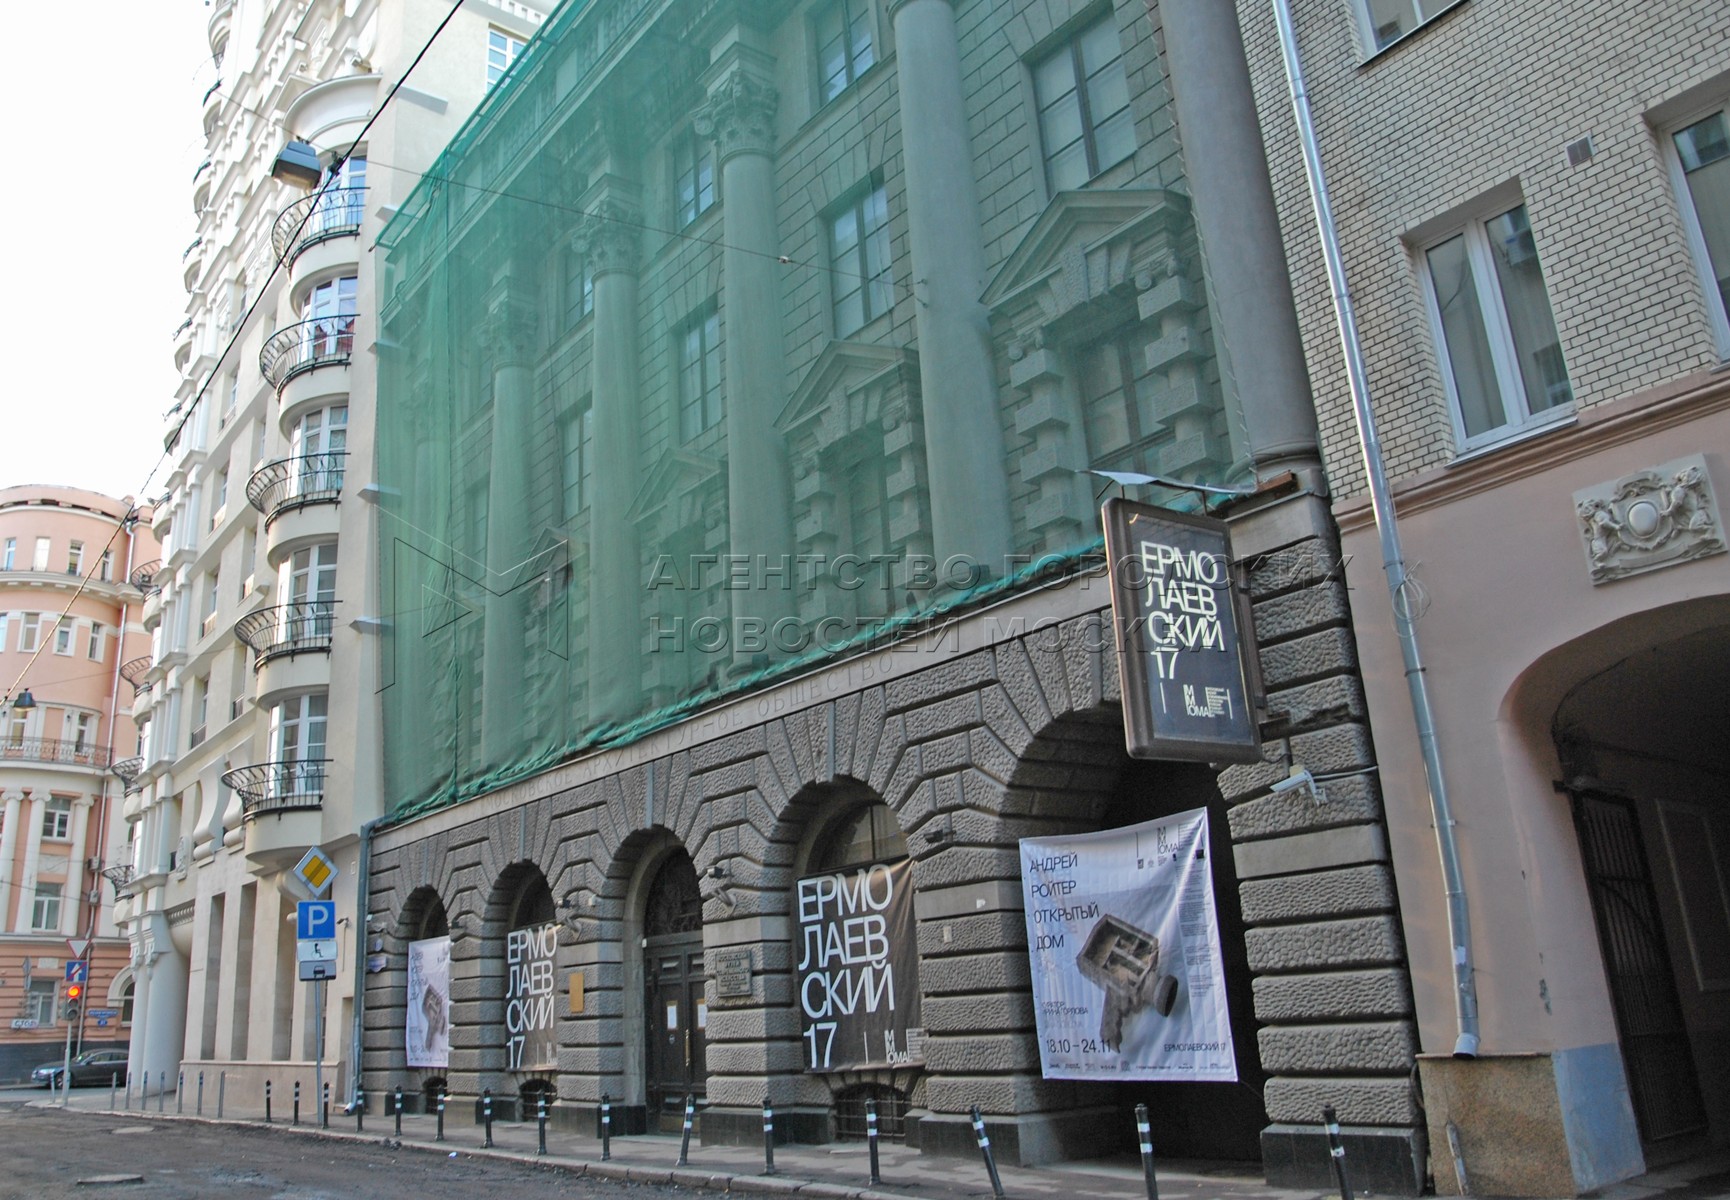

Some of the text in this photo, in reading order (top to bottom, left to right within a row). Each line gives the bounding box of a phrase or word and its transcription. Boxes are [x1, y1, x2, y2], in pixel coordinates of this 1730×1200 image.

[1140, 541, 1218, 584] ЕРМО
[1145, 576, 1218, 616] ЛАЕВ
[1148, 611, 1225, 651] СКИЙ
[1151, 647, 1179, 680] 17
[757, 654, 893, 718] ОБЩЕСТВО
[1030, 852, 1078, 874] АНДРЕЙ
[798, 864, 893, 923] ЕРМО
[1031, 880, 1077, 898] РОЙТЕР
[308, 904, 329, 936] P
[1034, 901, 1100, 924] ОТКРЫТЫЙ
[507, 923, 558, 965] ЕРМО
[798, 914, 889, 971] ЛАЕВ
[1036, 934, 1065, 952] ДОМ
[506, 960, 554, 999] ЛАЕВ
[801, 959, 895, 1019] СКИЙ
[506, 992, 555, 1034] СКИЙ
[506, 1035, 525, 1070] 17
[803, 1022, 838, 1069] 17
[1164, 1042, 1219, 1052] ЕРМОЛАЕВСКИЙ
